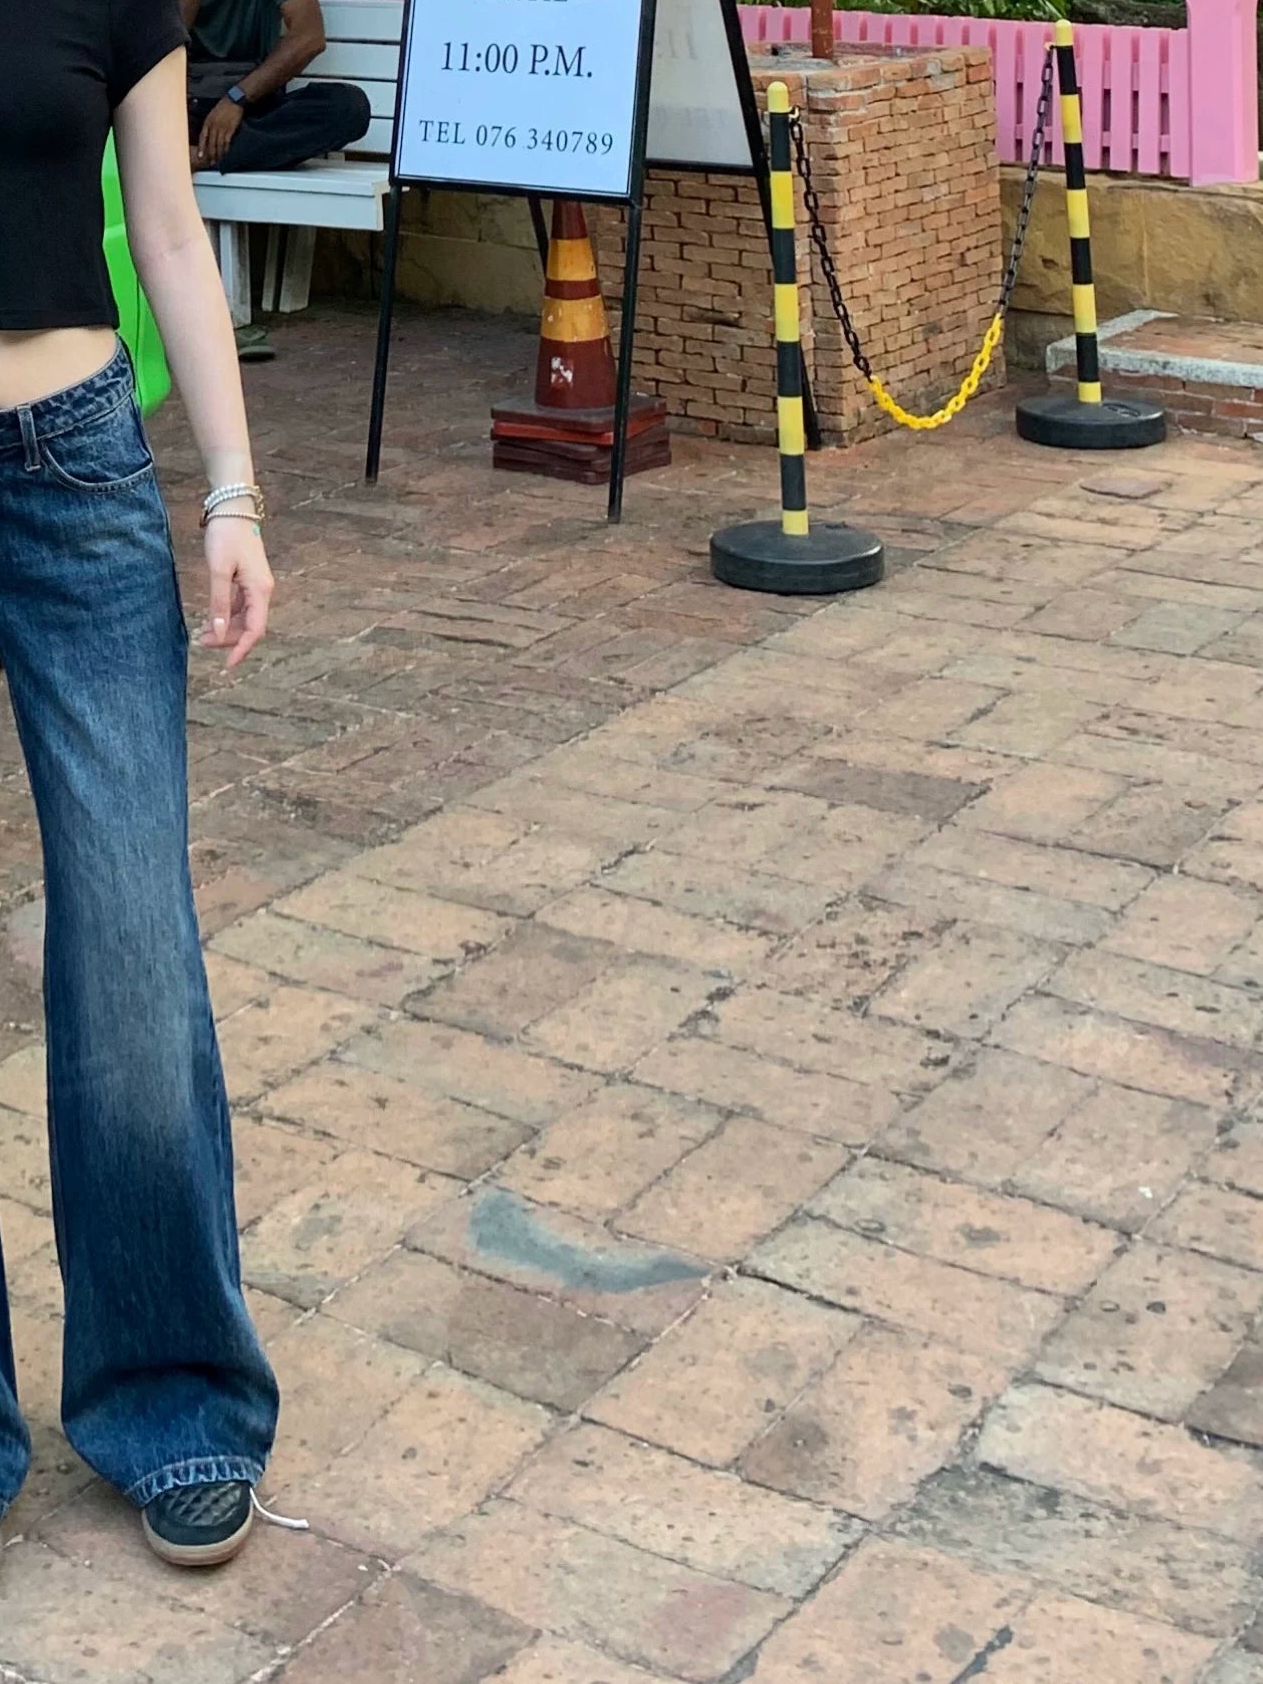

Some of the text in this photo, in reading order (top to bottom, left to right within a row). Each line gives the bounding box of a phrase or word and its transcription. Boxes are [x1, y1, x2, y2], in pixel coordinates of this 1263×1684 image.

[440, 41, 593, 79] 11:00 P.M.
[418, 119, 614, 156] TEL 076 340789
